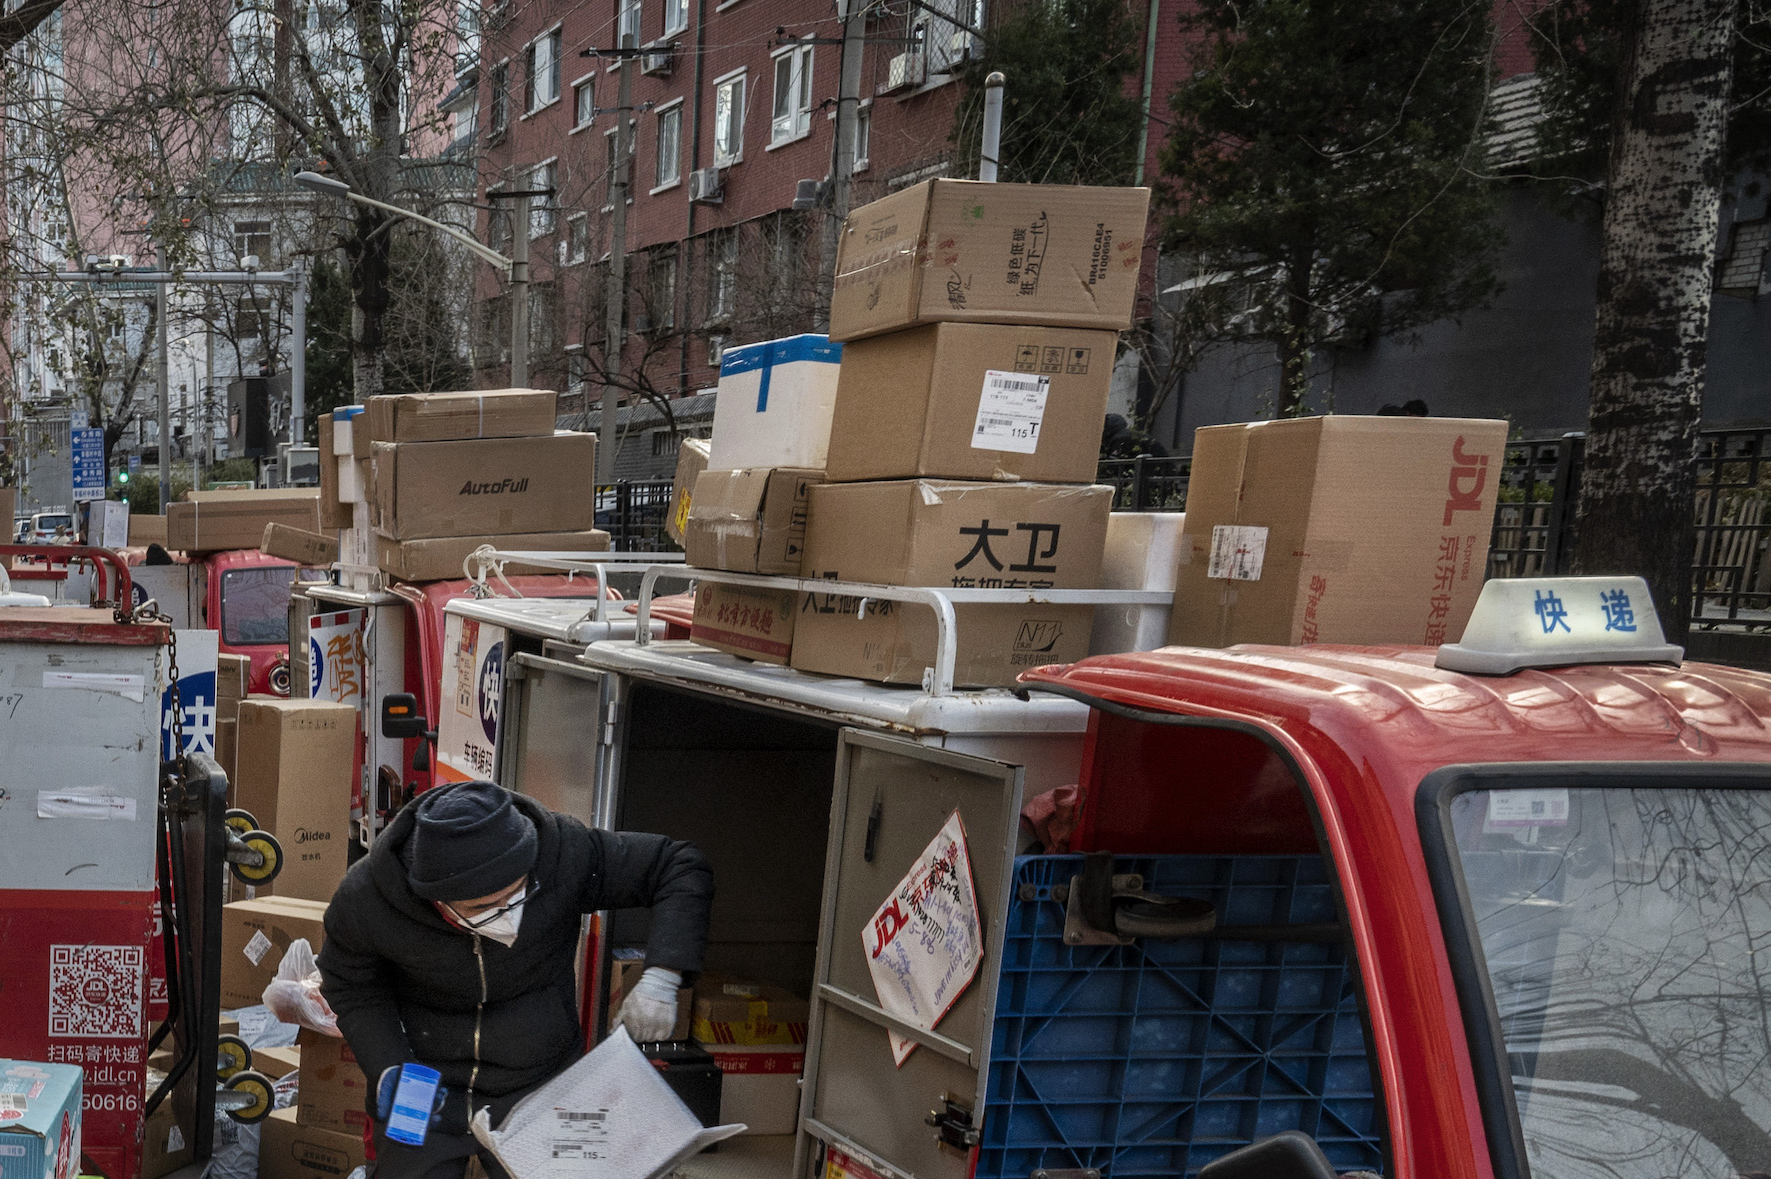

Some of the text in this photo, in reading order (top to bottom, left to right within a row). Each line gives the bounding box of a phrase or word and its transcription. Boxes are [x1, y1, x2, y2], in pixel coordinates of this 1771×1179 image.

[1007, 225, 1027, 287] 绿色低碳
[1012, 428, 1027, 438] 115
[459, 476, 529, 496] AutoFull
[1443, 436, 1489, 526] JDL
[957, 520, 1061, 574] 大卫
[1460, 535, 1477, 581] Express
[1535, 589, 1638, 634] 快递
[294, 828, 331, 843] Midea
[873, 897, 909, 958] JDL
[48, 1045, 140, 1064] 扫码寄快递
[83, 1066, 137, 1082] .jdl.cn
